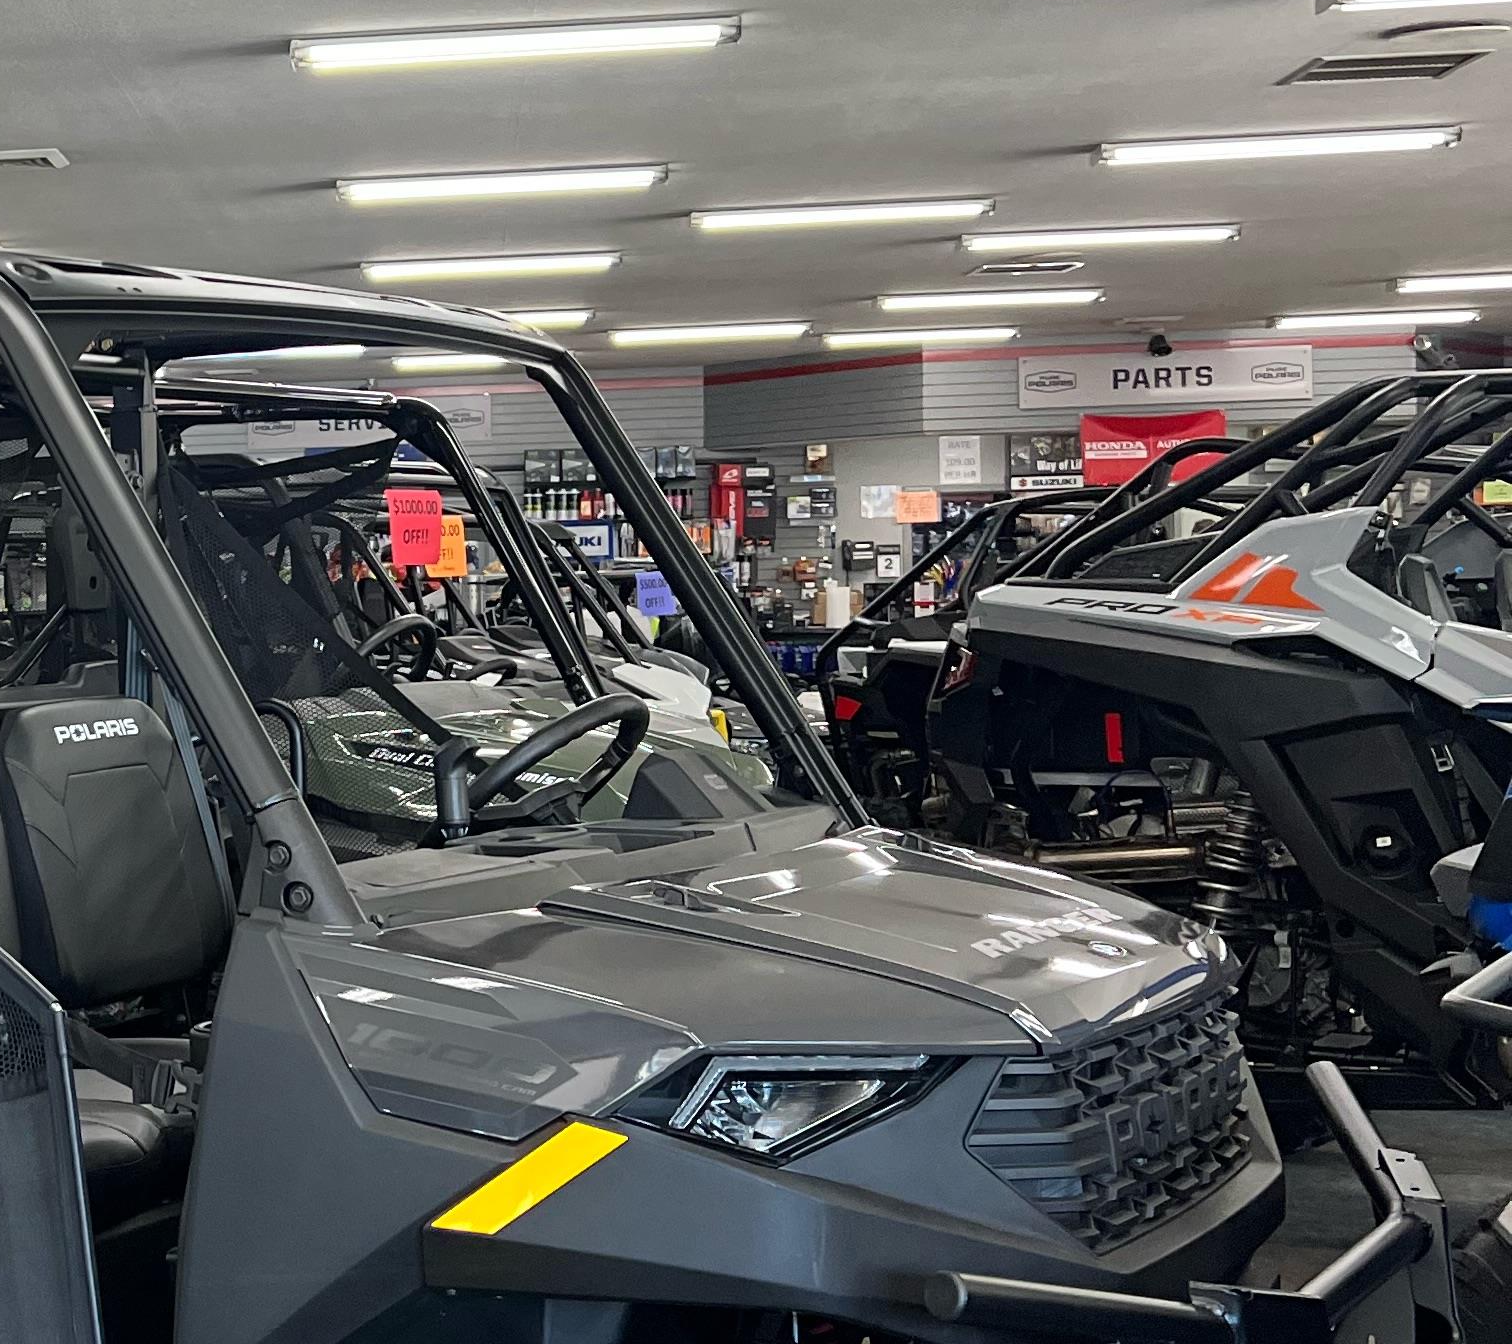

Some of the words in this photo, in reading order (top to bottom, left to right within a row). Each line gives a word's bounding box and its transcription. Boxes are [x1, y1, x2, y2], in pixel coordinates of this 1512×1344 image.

[1112, 366, 1213, 390] PARTS
[1084, 440, 1147, 451] HONDA
[1037, 459, 1057, 473] Way
[1059, 459, 1069, 471] of
[1032, 478, 1078, 487] SUZUKI
[393, 498, 438, 516] $1000.00
[402, 528, 429, 545] OFF!!
[884, 558, 893, 570] 2
[1043, 597, 1180, 616] PRO
[53, 717, 140, 745] POLARIS
[970, 907, 1124, 959] RANGER
